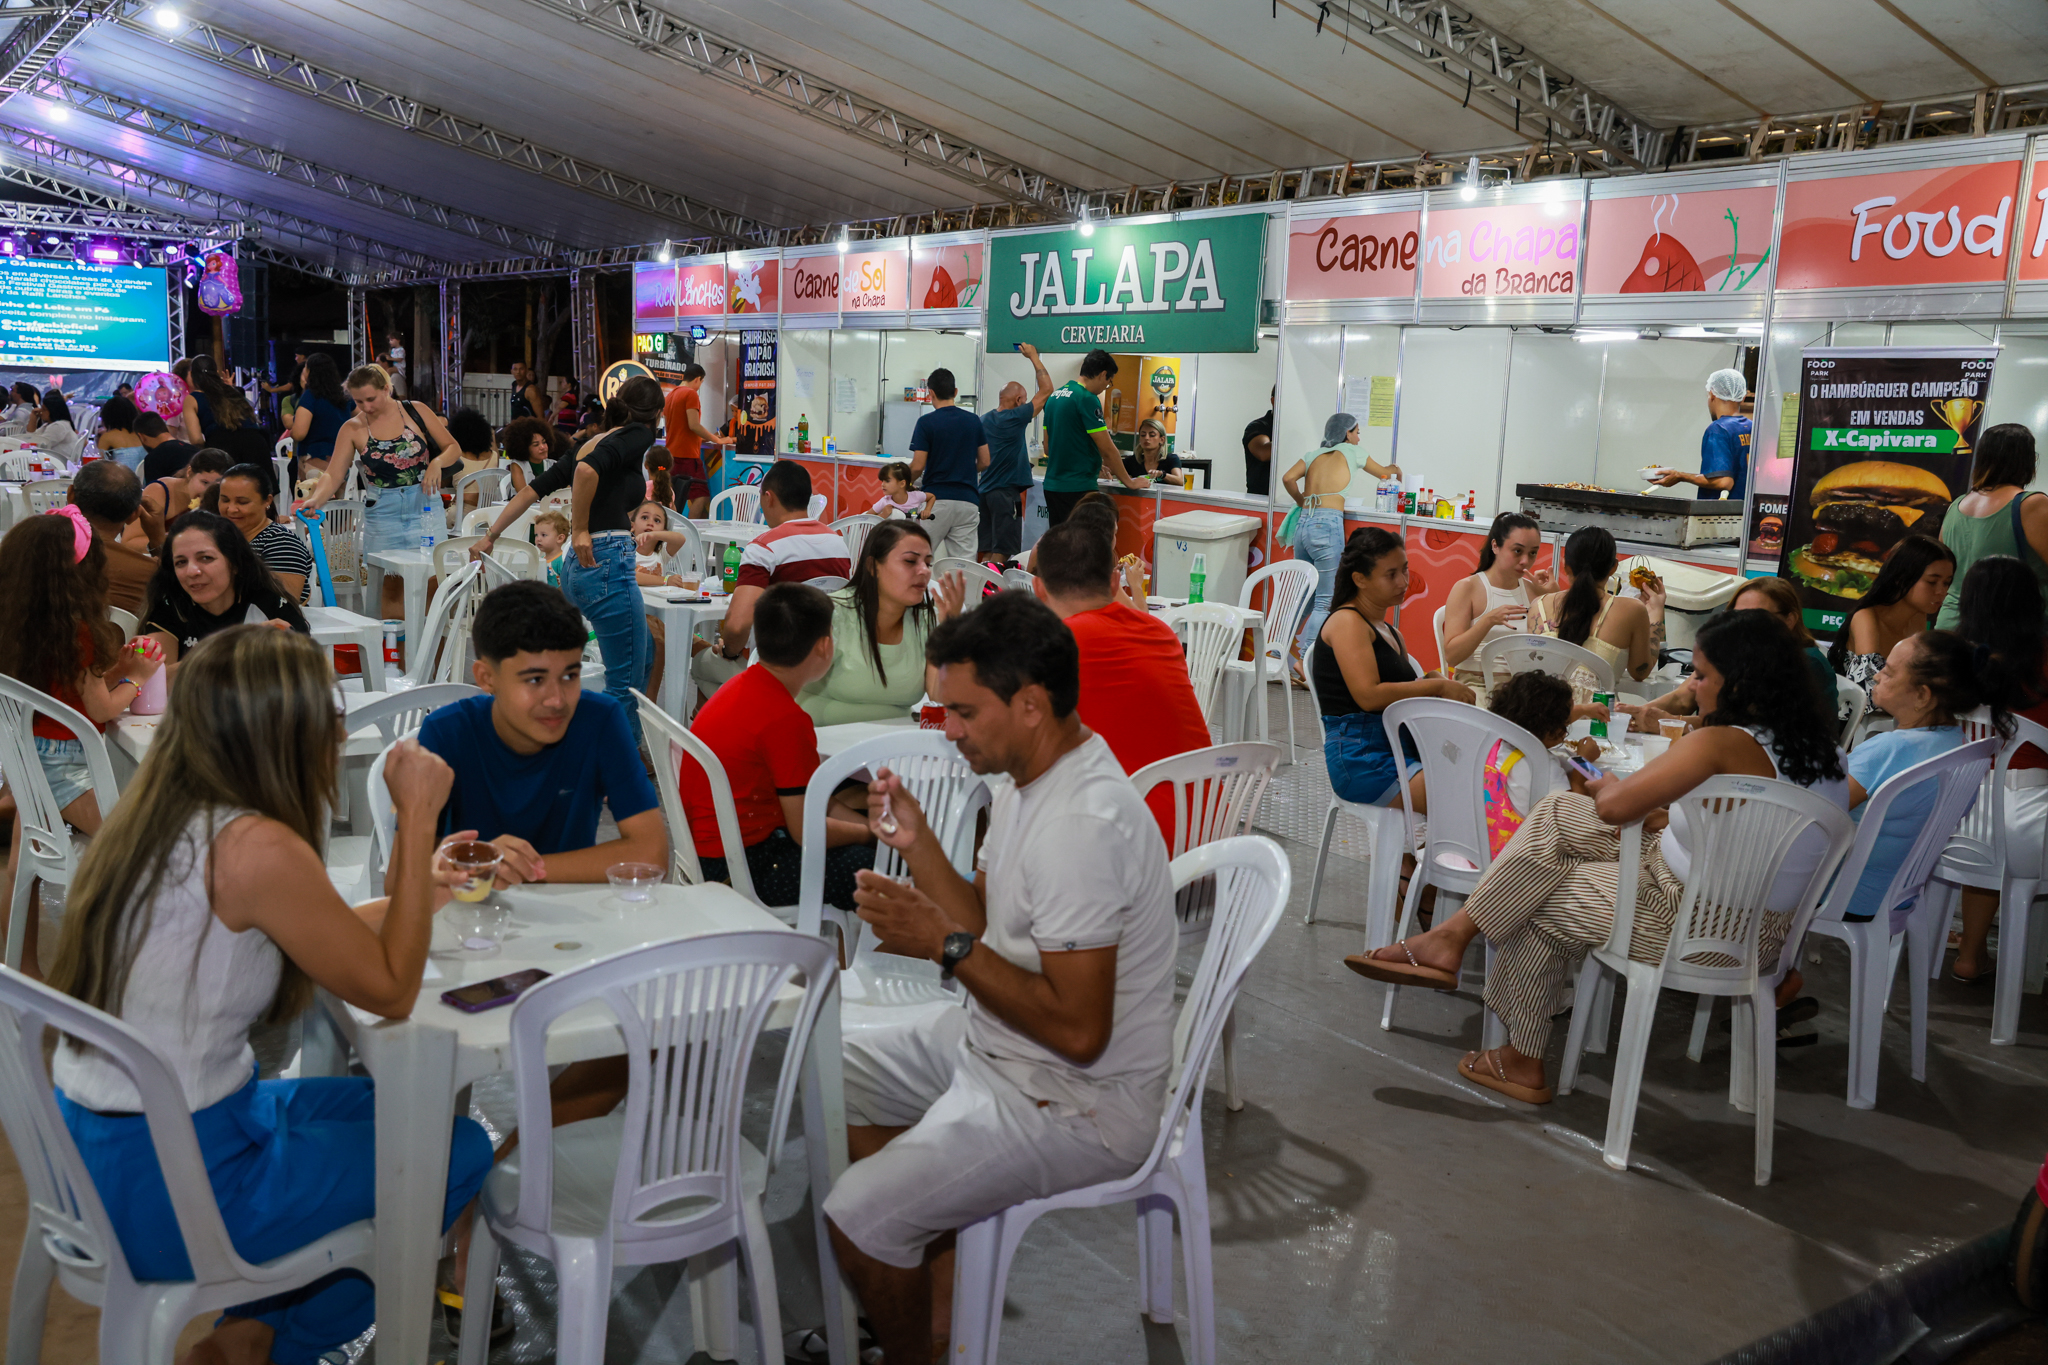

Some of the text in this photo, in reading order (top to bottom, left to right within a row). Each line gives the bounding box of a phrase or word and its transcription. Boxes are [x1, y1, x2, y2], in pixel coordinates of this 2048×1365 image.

[1851, 195, 2012, 262] Food
[1316, 220, 1578, 273] Carne na Chapa
[10, 260, 74, 271] GABRIELA
[77, 265, 113, 274] RAFFI
[794, 258, 887, 300] Carne de Sol
[1010, 239, 1227, 318] JALAPA
[1462, 267, 1574, 296] da Branca
[44, 303, 72, 311] Leite
[851, 298, 861, 309] na
[29, 311, 77, 319] completa
[1061, 325, 1146, 344] CERVEJARIA
[748, 343, 772, 360] NO PÃO
[645, 358, 687, 372] TURBINADO
[744, 362, 775, 376] GRACIOSA
[1807, 361, 1836, 369] FOOD
[1960, 361, 1994, 370] FOOD
[1152, 375, 1175, 384] JALAPA
[1809, 377, 1979, 399] O HAMBÚRGUER CAMPEÃO
[1850, 410, 1924, 426] EM VENDAS
[1823, 430, 1938, 451] X-Capivara
[1759, 502, 1788, 515] FOME
[1176, 540, 1188, 552] V3
